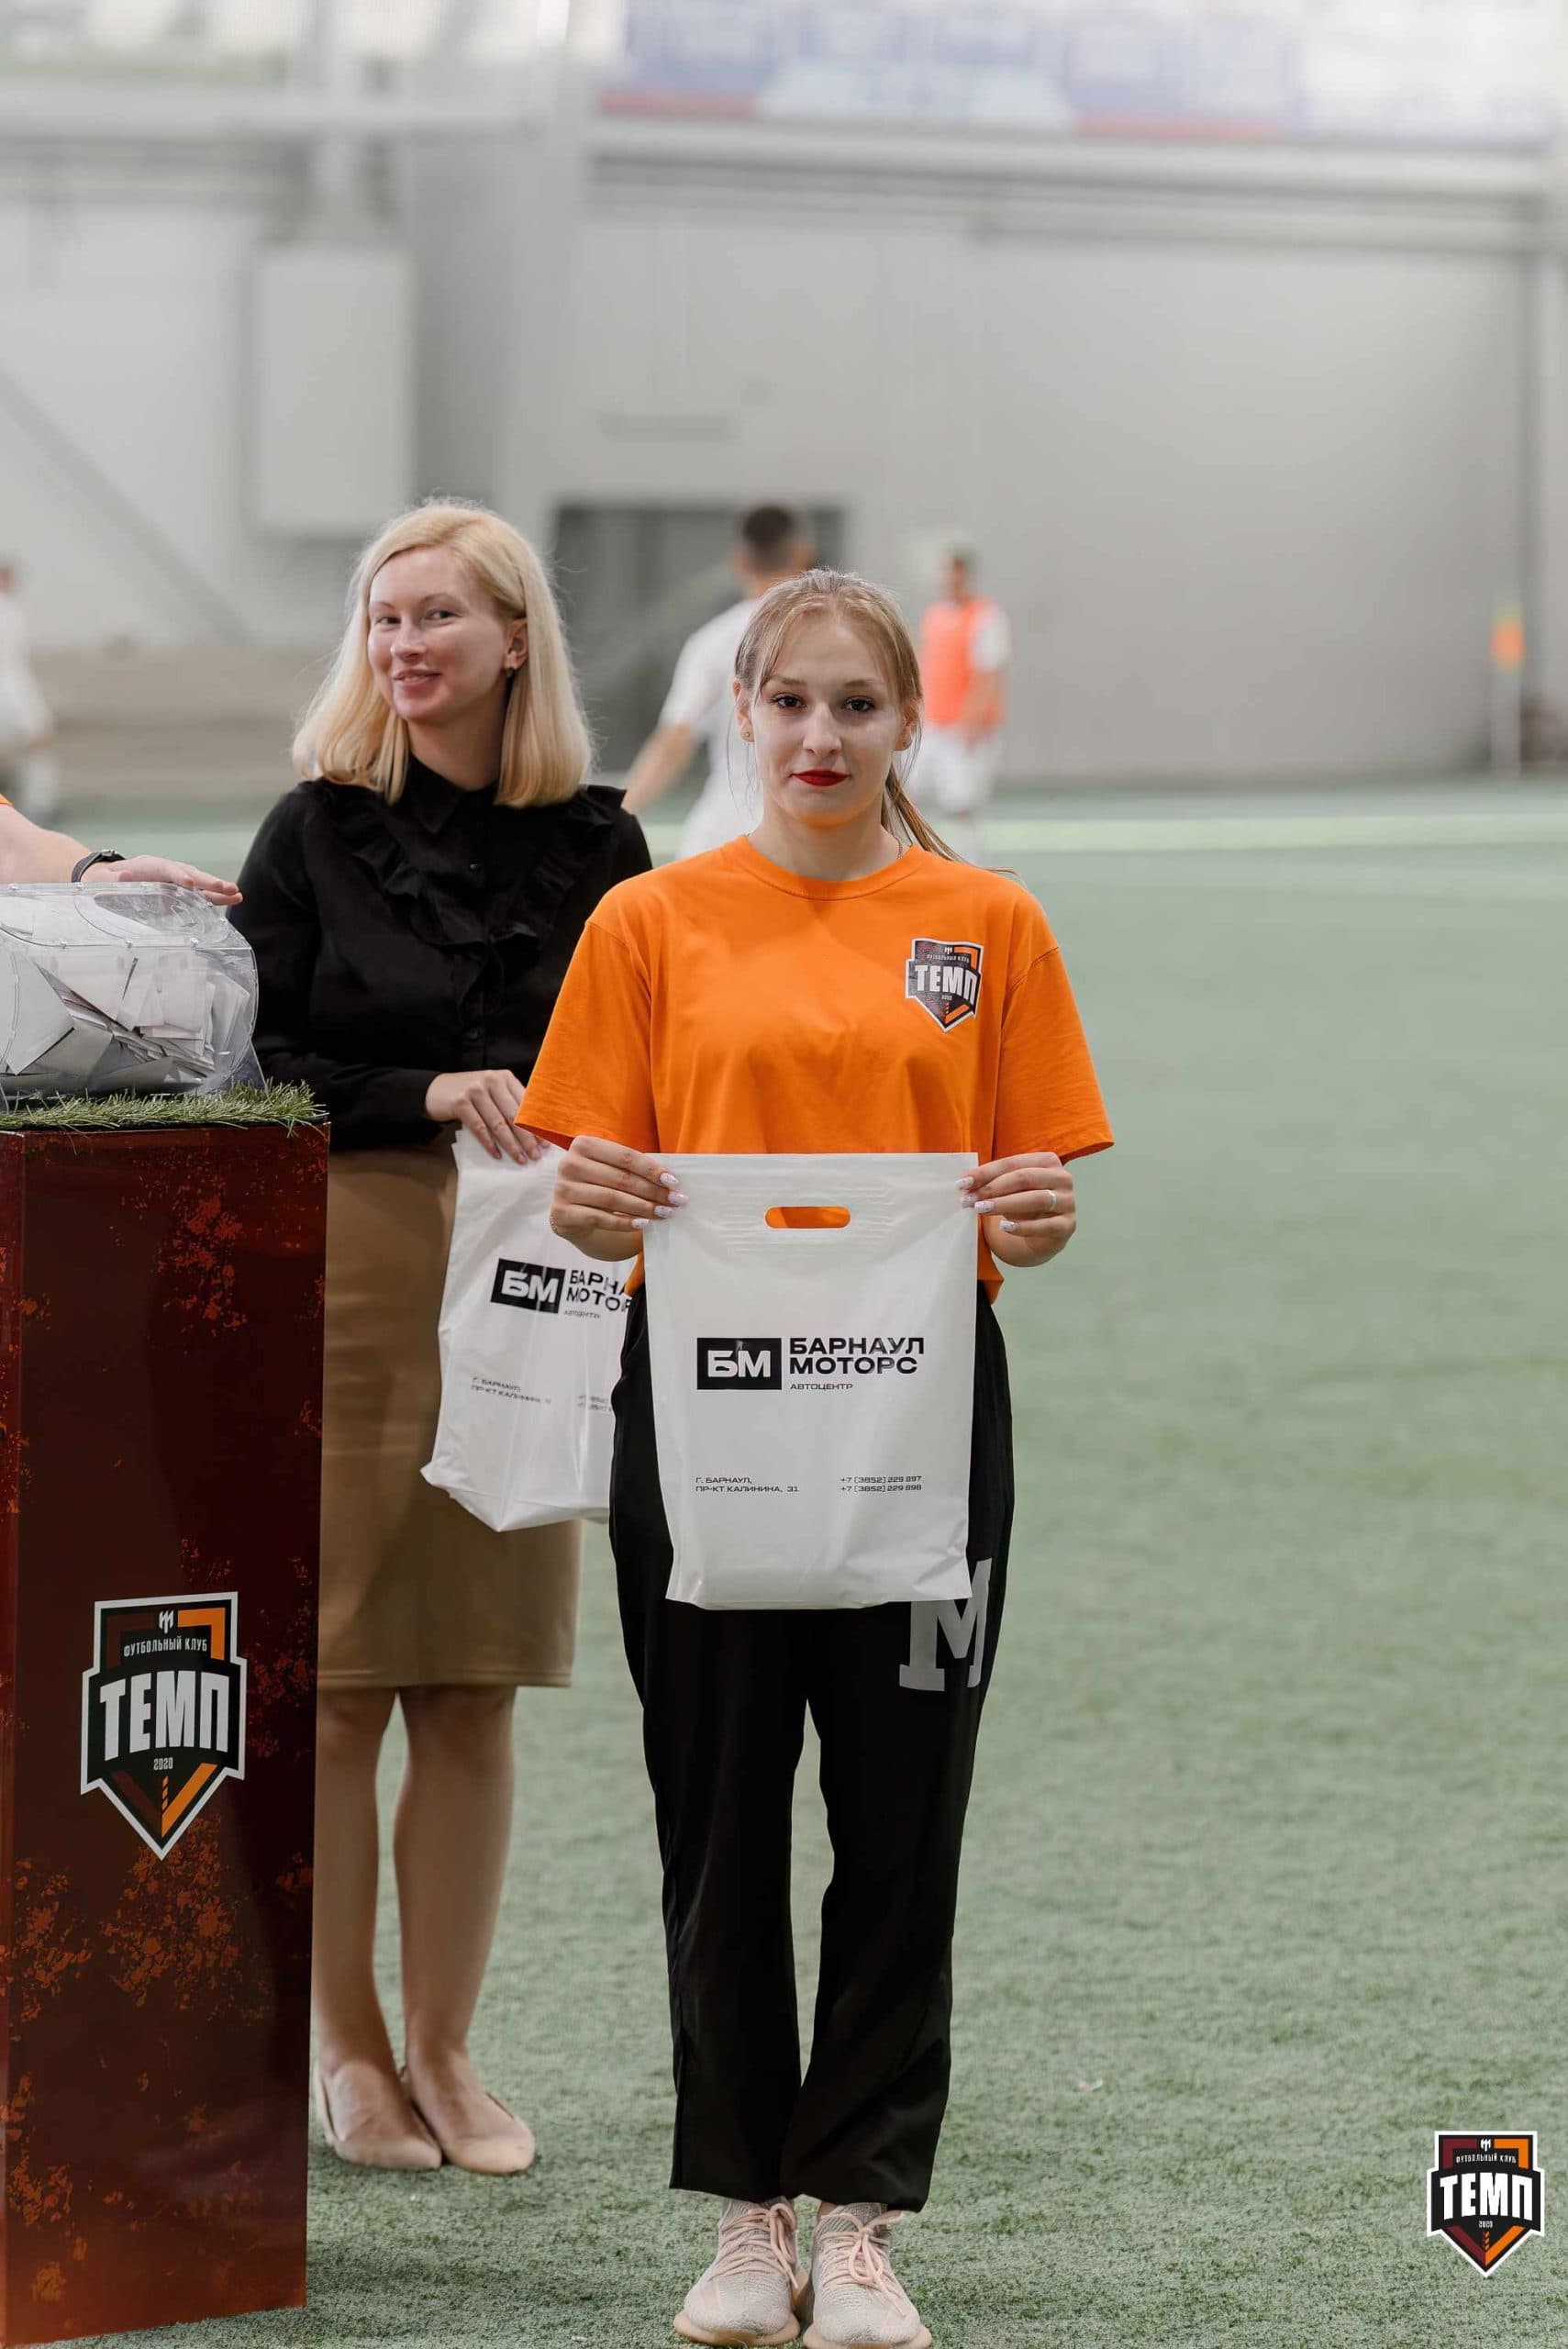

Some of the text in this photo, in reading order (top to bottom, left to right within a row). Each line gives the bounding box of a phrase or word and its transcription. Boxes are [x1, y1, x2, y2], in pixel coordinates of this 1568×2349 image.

[914, 964, 978, 1005] ТЕМП
[501, 1270, 559, 1303] БМ
[790, 1337, 925, 1354] БАРНАУЛ
[707, 1350, 772, 1378] БМ
[790, 1356, 918, 1375] МОТОРС
[790, 1383, 853, 1391] АВТОЦЕНТР
[706, 1476, 752, 1485] БАРНАУЛ,
[123, 1635, 207, 1657] ФУТБОЛЬНЫЙ КЛУБ
[100, 1670, 230, 1762] ТЕМП
[153, 1757, 173, 1771] 2020
